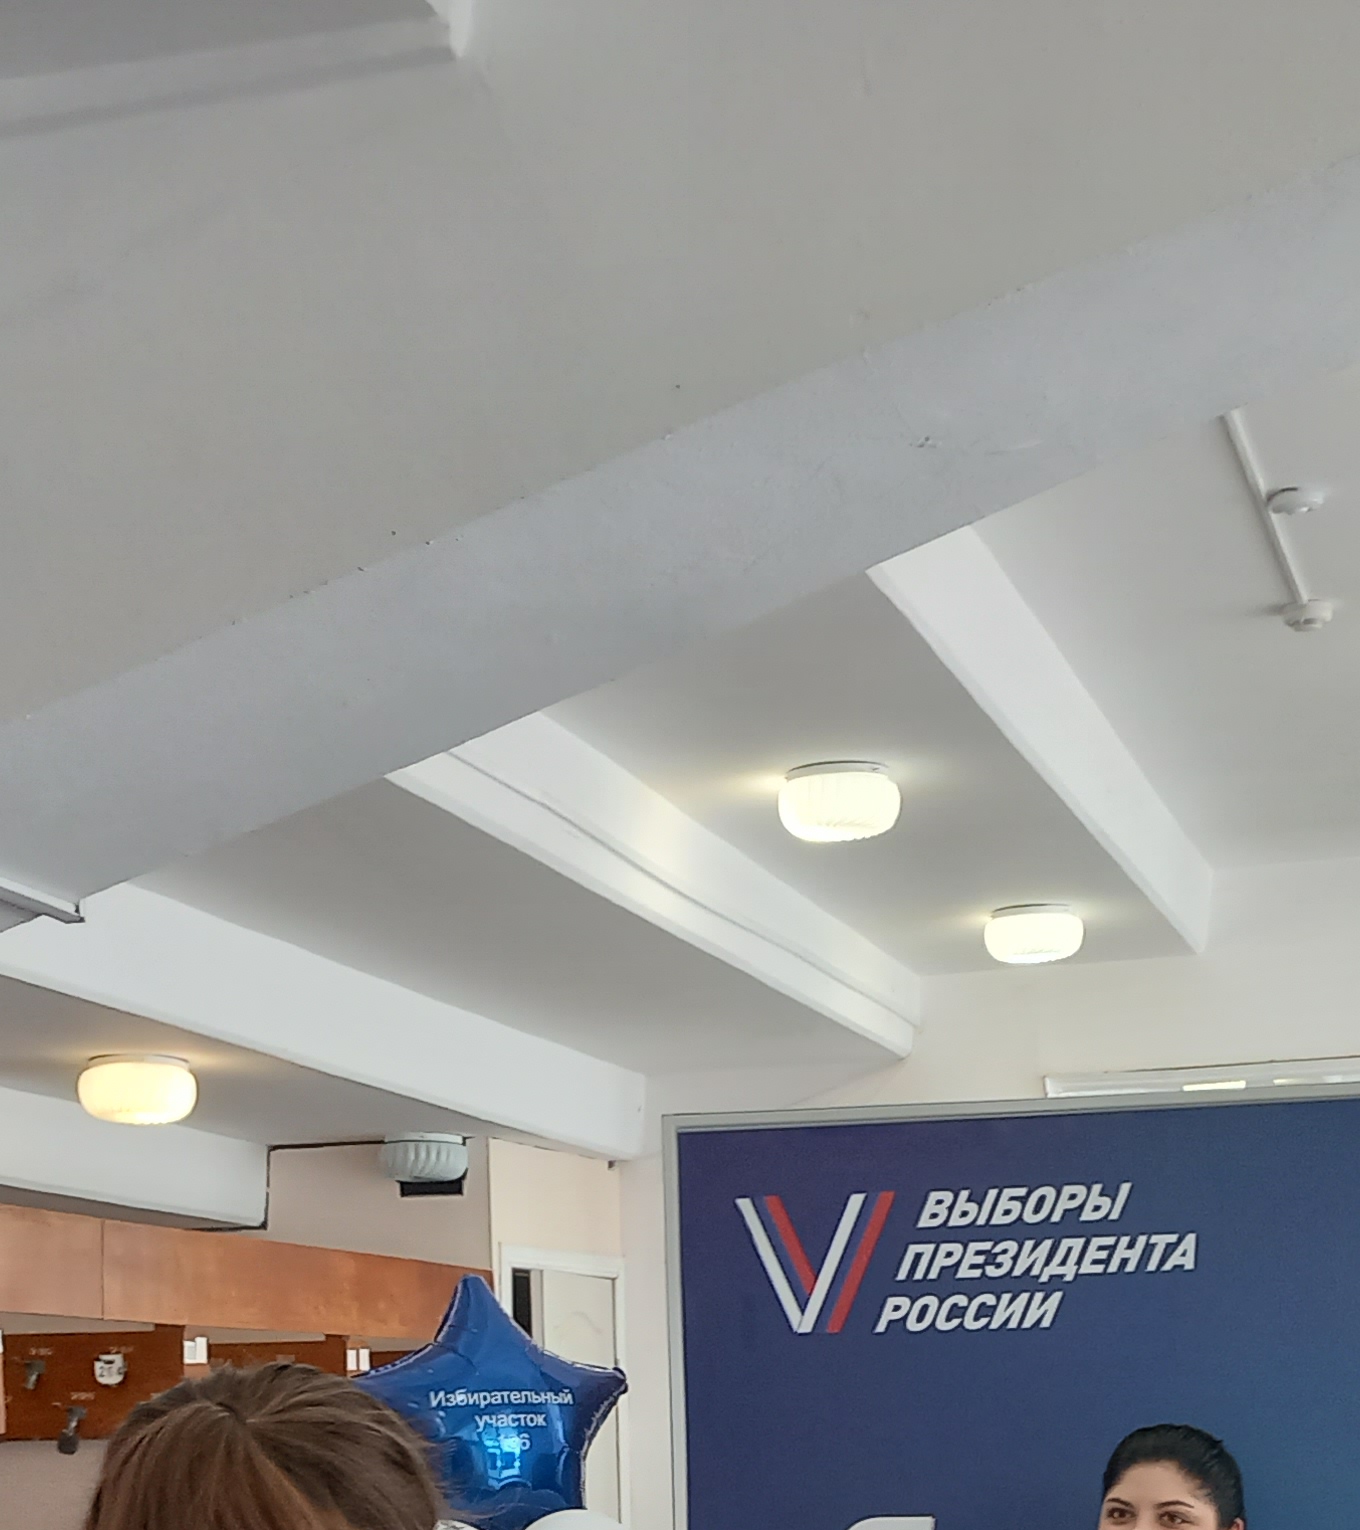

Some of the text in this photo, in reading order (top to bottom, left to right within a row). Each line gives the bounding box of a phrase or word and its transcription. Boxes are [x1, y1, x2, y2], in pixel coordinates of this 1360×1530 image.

[915, 1181, 1133, 1229] ВЫБОРЫ
[894, 1231, 1197, 1283] ПРЕЗИДЕНТА
[871, 1290, 1064, 1334] РОССИИ
[429, 1387, 574, 1409] Избирательный
[474, 1413, 548, 1432] участок
